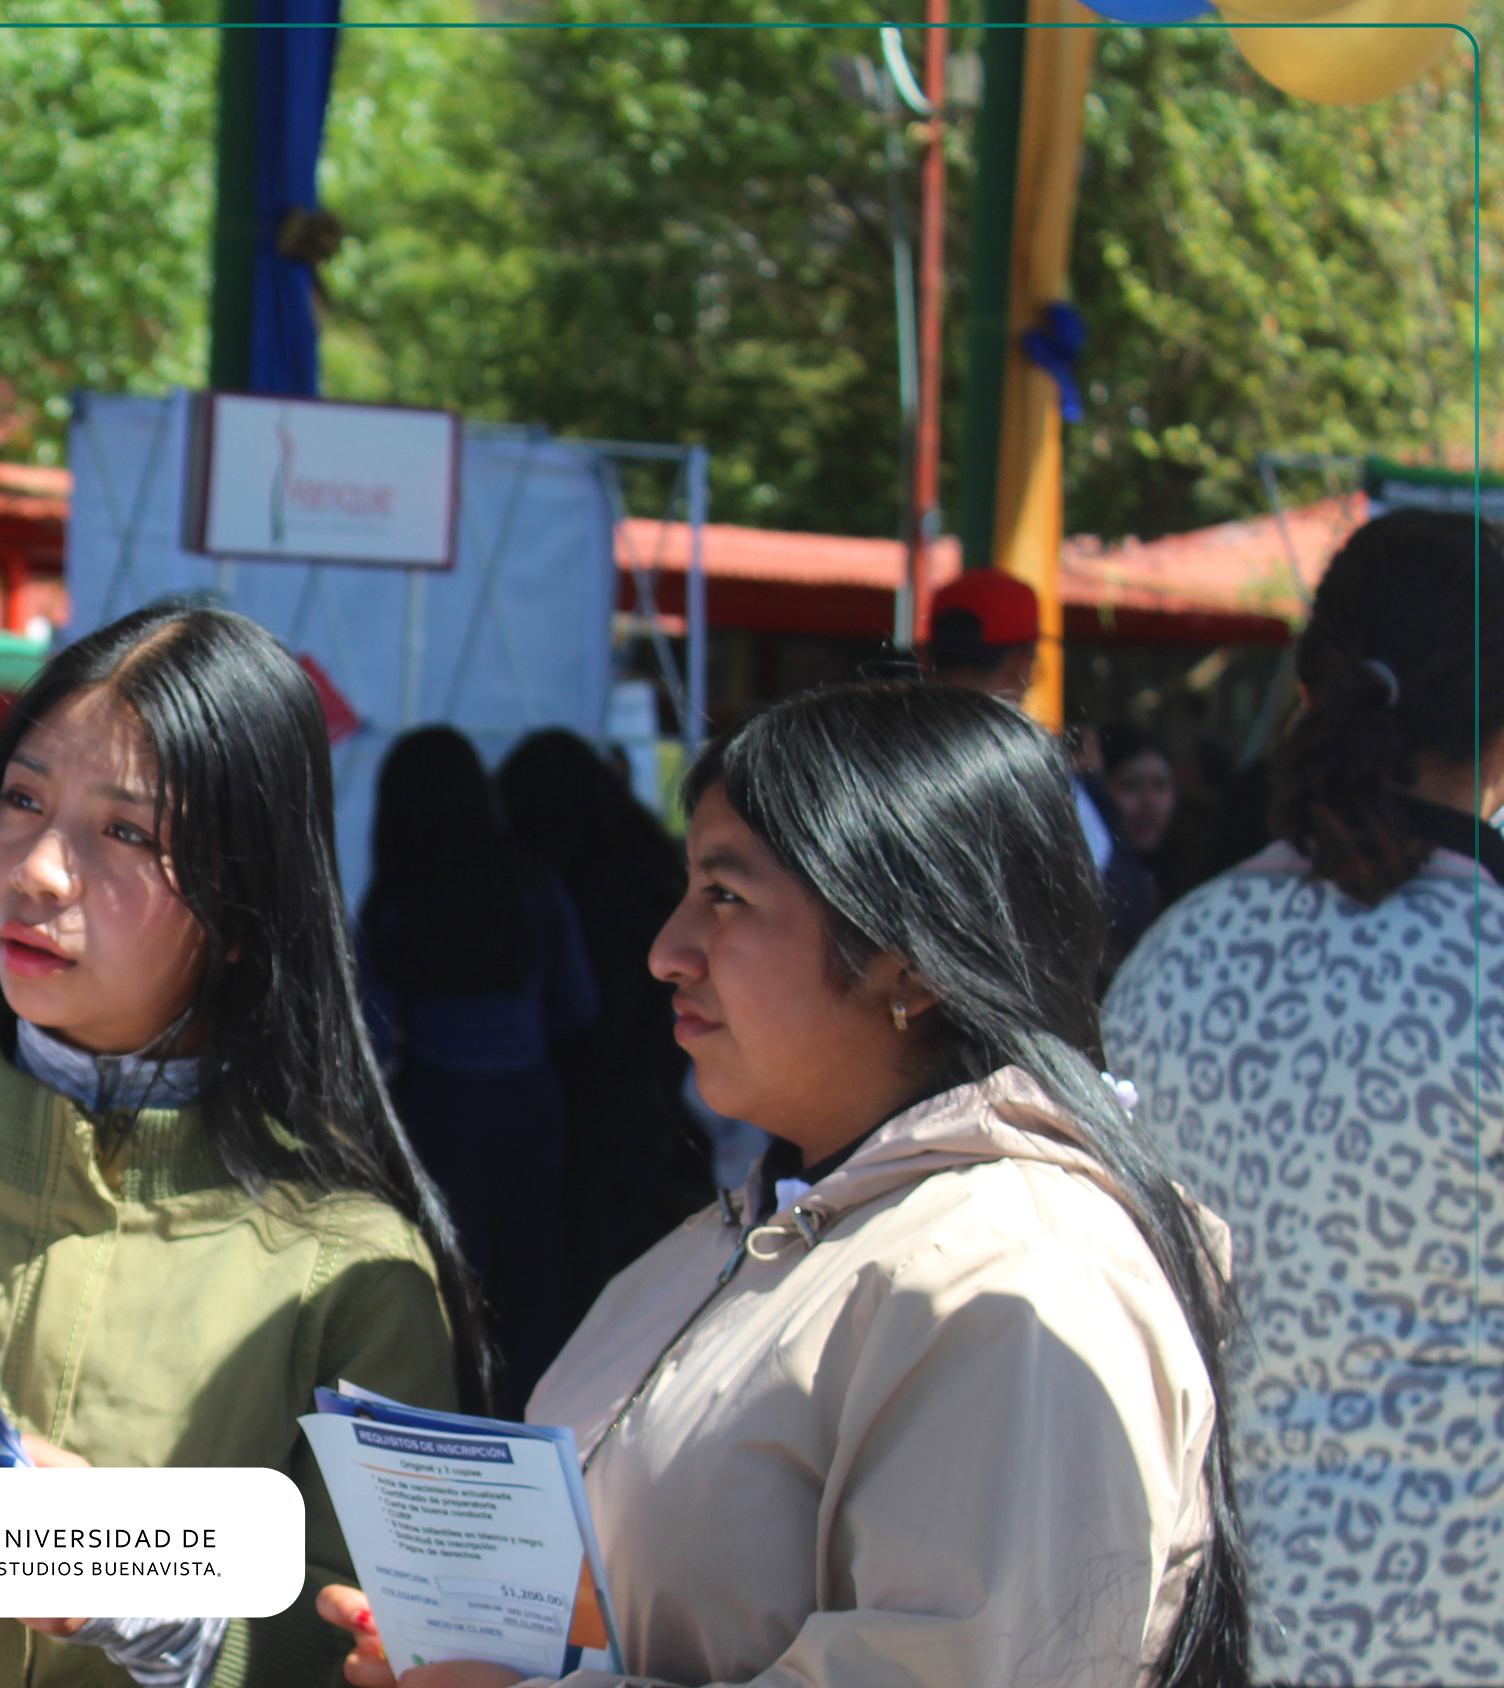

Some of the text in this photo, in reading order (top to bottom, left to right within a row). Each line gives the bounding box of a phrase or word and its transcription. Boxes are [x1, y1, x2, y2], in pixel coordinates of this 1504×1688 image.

[358, 1430, 508, 1459] REQUISITOS DE INSCRIPCIÓN
[400, 1459, 434, 1472] Original
[500, 1584, 563, 1607] $1,200.00
